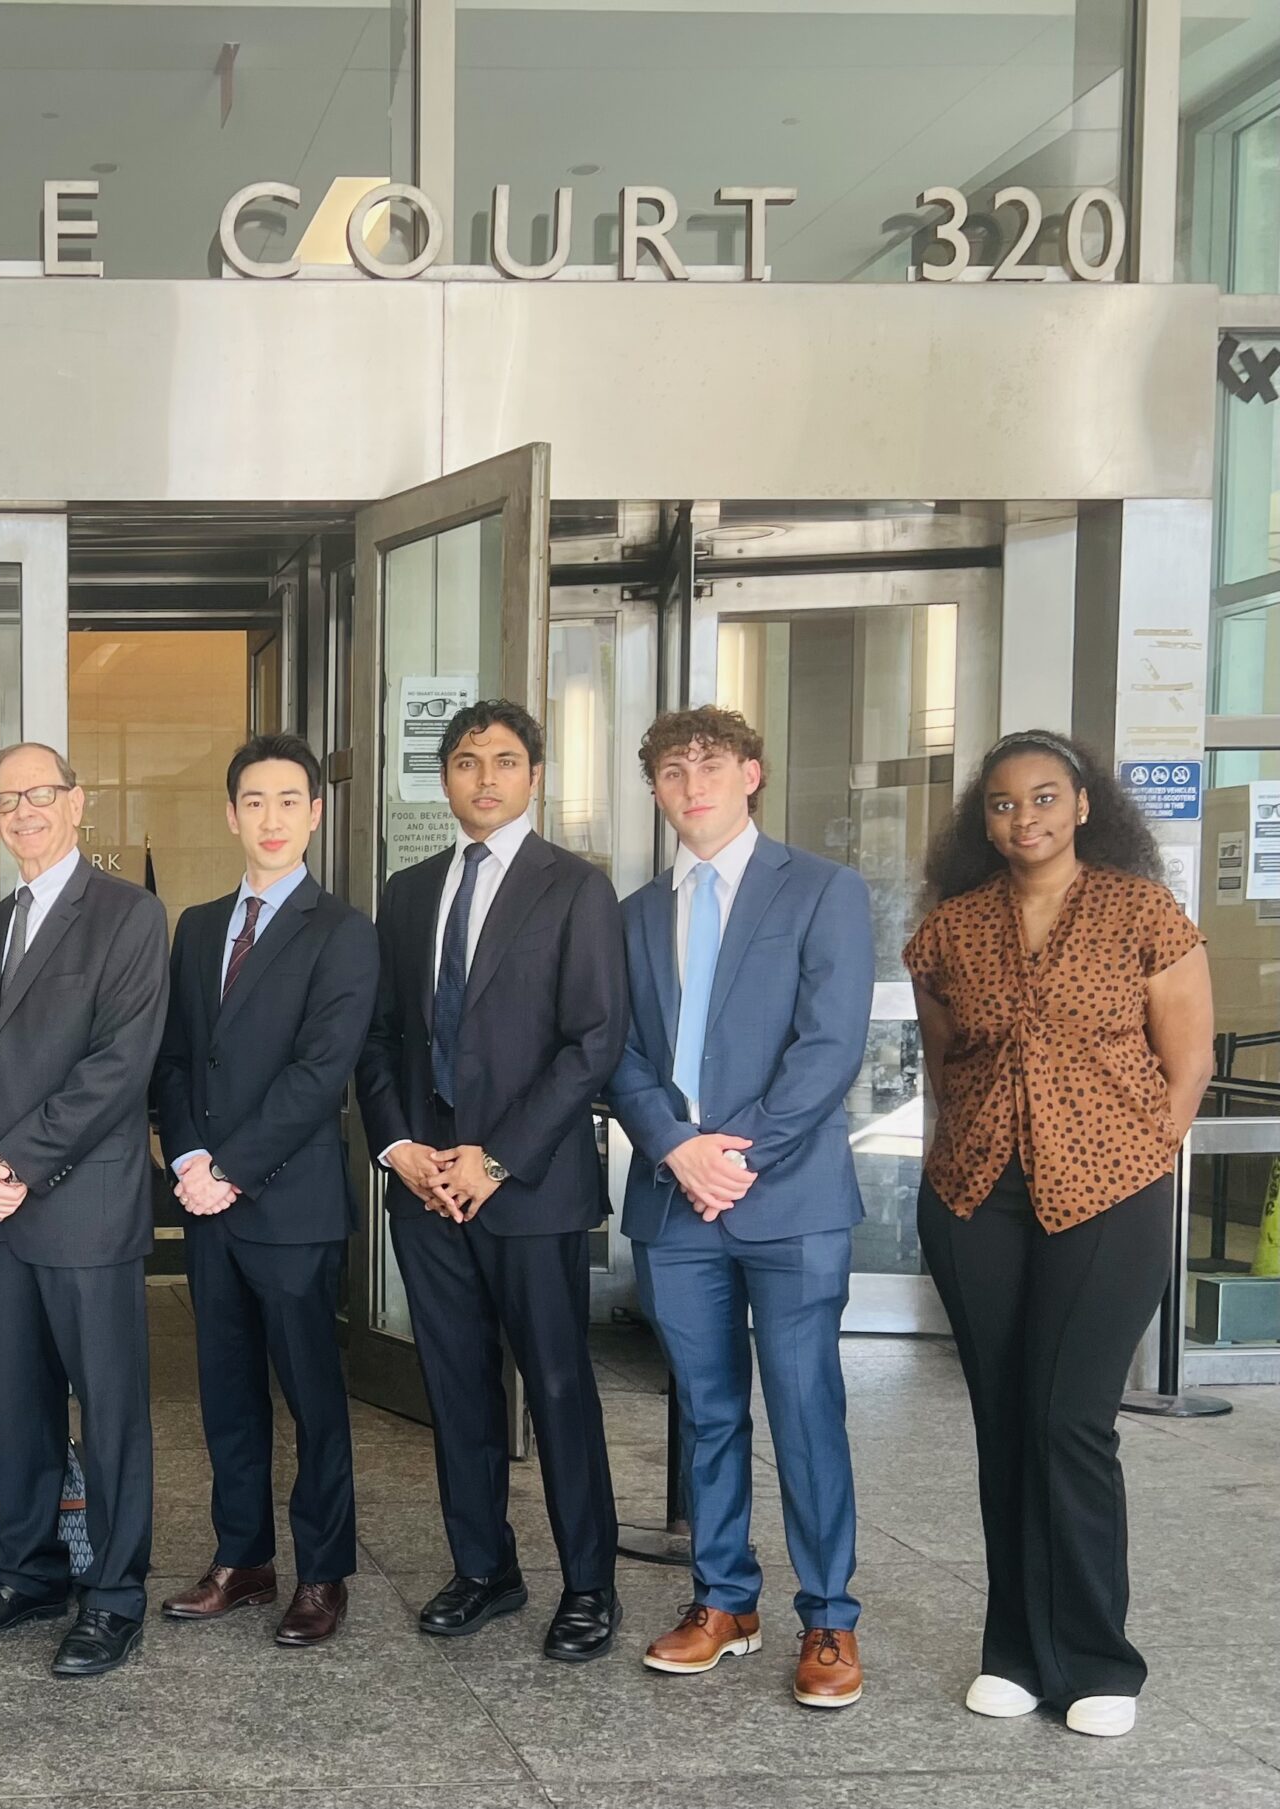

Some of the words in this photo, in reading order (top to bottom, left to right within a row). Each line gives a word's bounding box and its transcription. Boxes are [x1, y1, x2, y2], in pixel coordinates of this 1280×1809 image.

[219, 180, 798, 282] COURT
[919, 186, 1126, 282] 320
[419, 811, 454, 820] BEVERA
[406, 823, 424, 831] AND
[427, 822, 455, 831] GLASS
[392, 833, 448, 842] CONTAINERS
[399, 856, 419, 864] THIS
